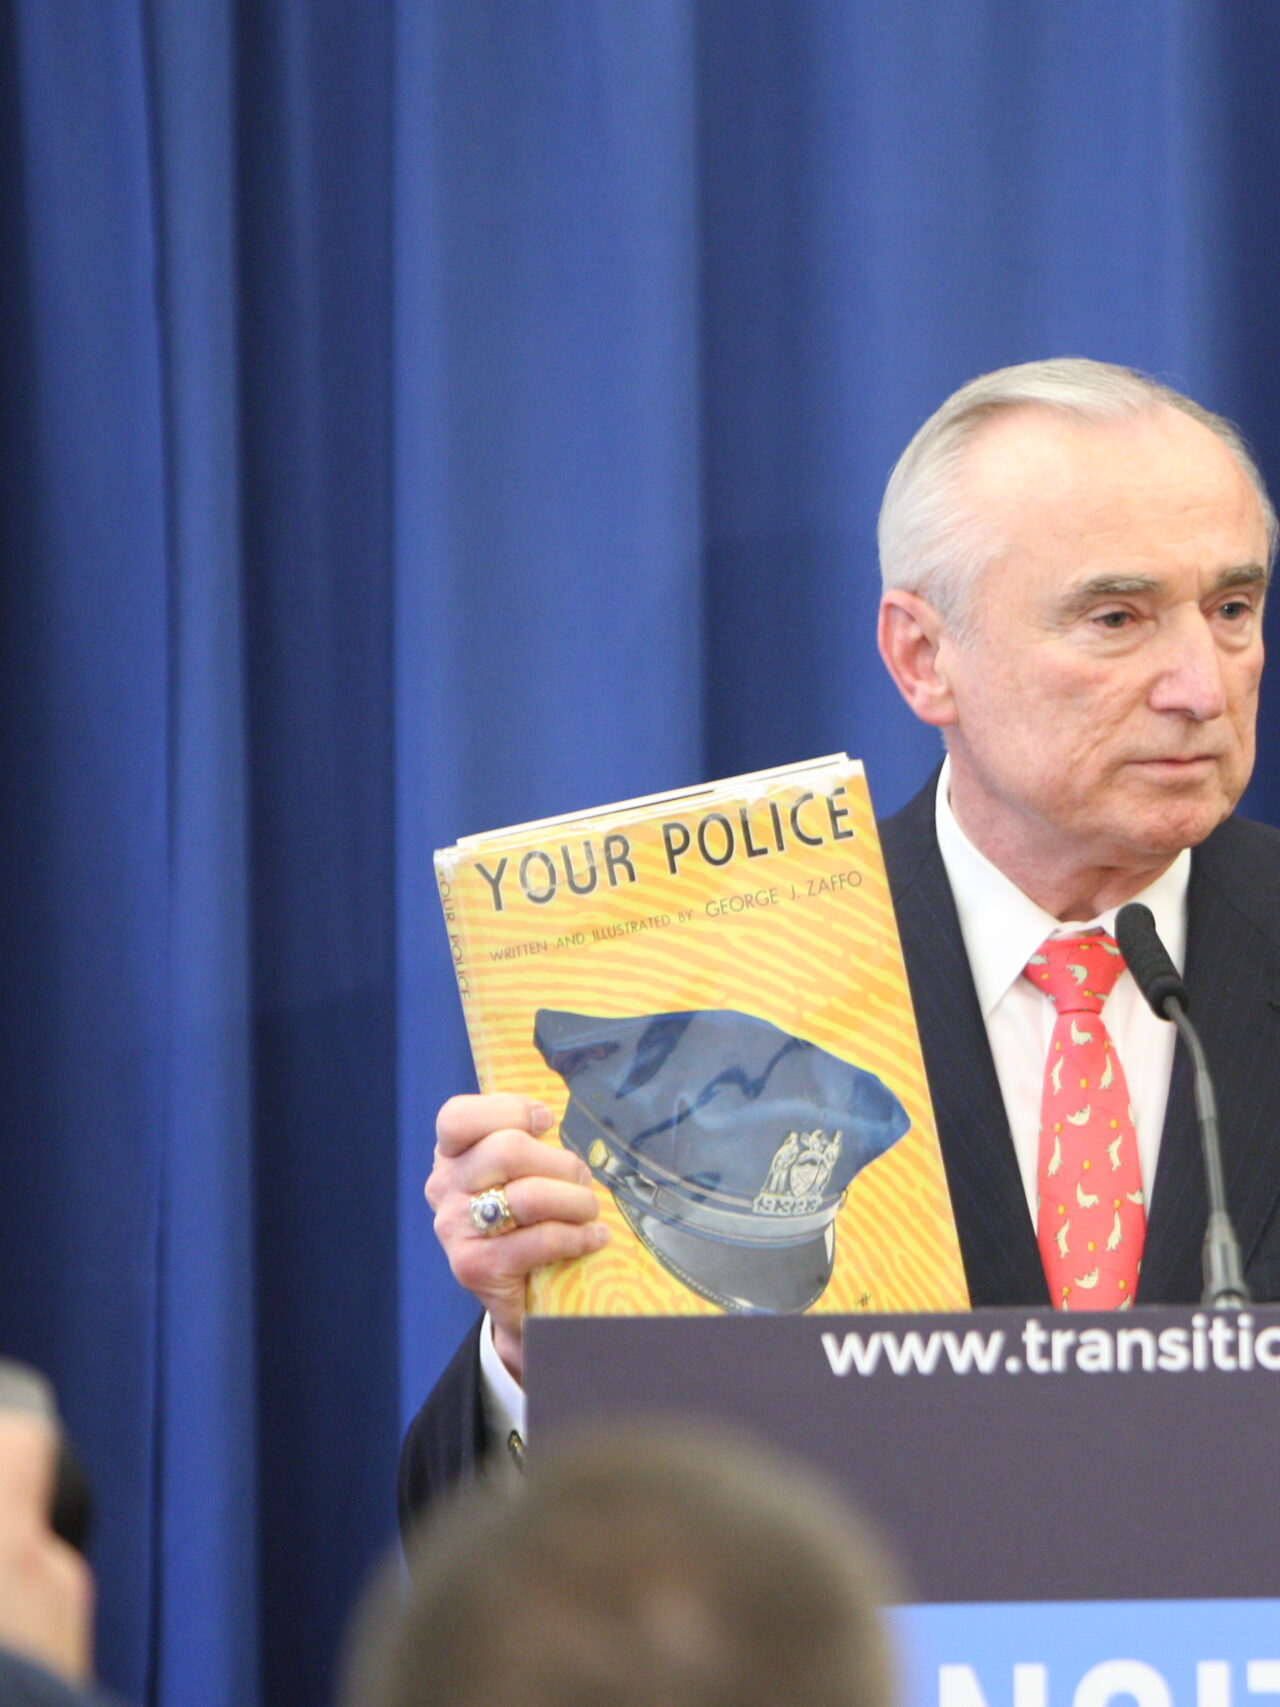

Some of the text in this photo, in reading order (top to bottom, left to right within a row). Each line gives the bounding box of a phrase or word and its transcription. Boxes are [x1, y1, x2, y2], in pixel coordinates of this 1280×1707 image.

[475, 787, 854, 911] YOUR POLICE
[489, 870, 862, 962] WRITTEN AND ILLUSTRATED BY GEORGE J. ZAFFO
[450, 934, 471, 999] POLICE
